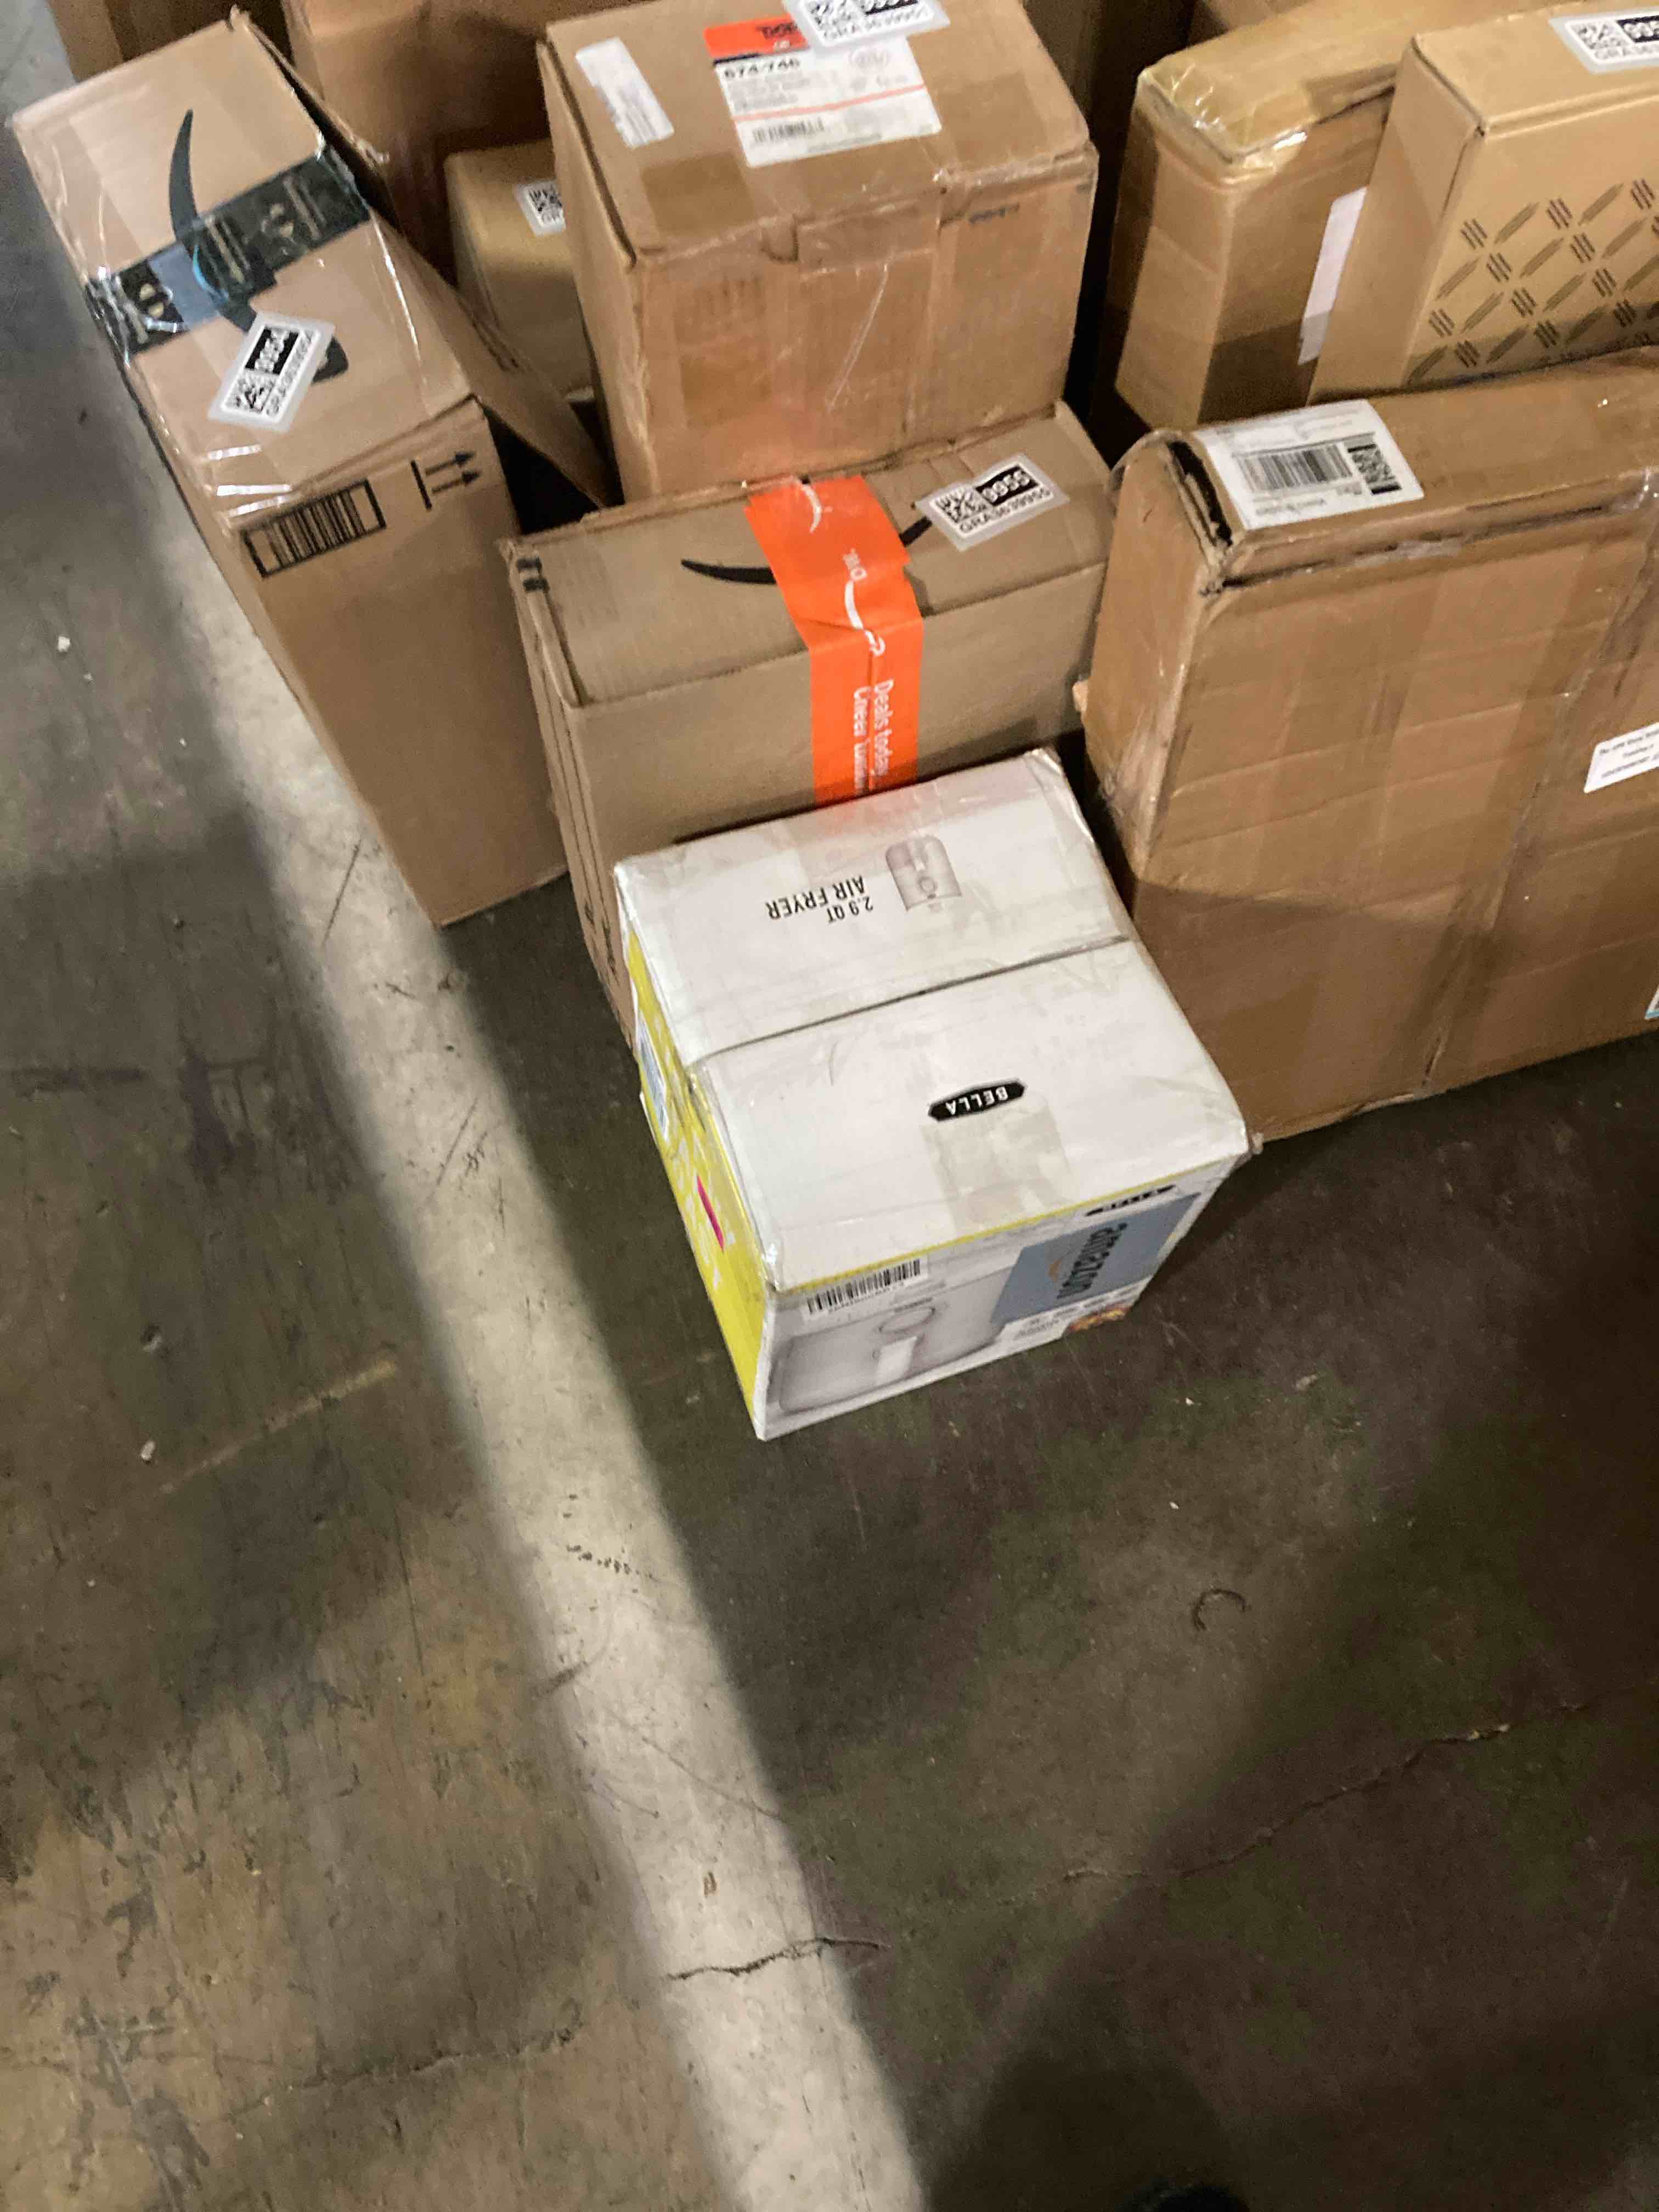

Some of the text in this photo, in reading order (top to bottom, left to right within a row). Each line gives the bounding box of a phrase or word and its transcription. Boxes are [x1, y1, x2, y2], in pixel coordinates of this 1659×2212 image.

[874, 679, 894, 729] Deals
[765, 875, 865, 920] AIR FRYER
[826, 904, 846, 924] QT
[945, 1086, 1009, 1116] BELLA
